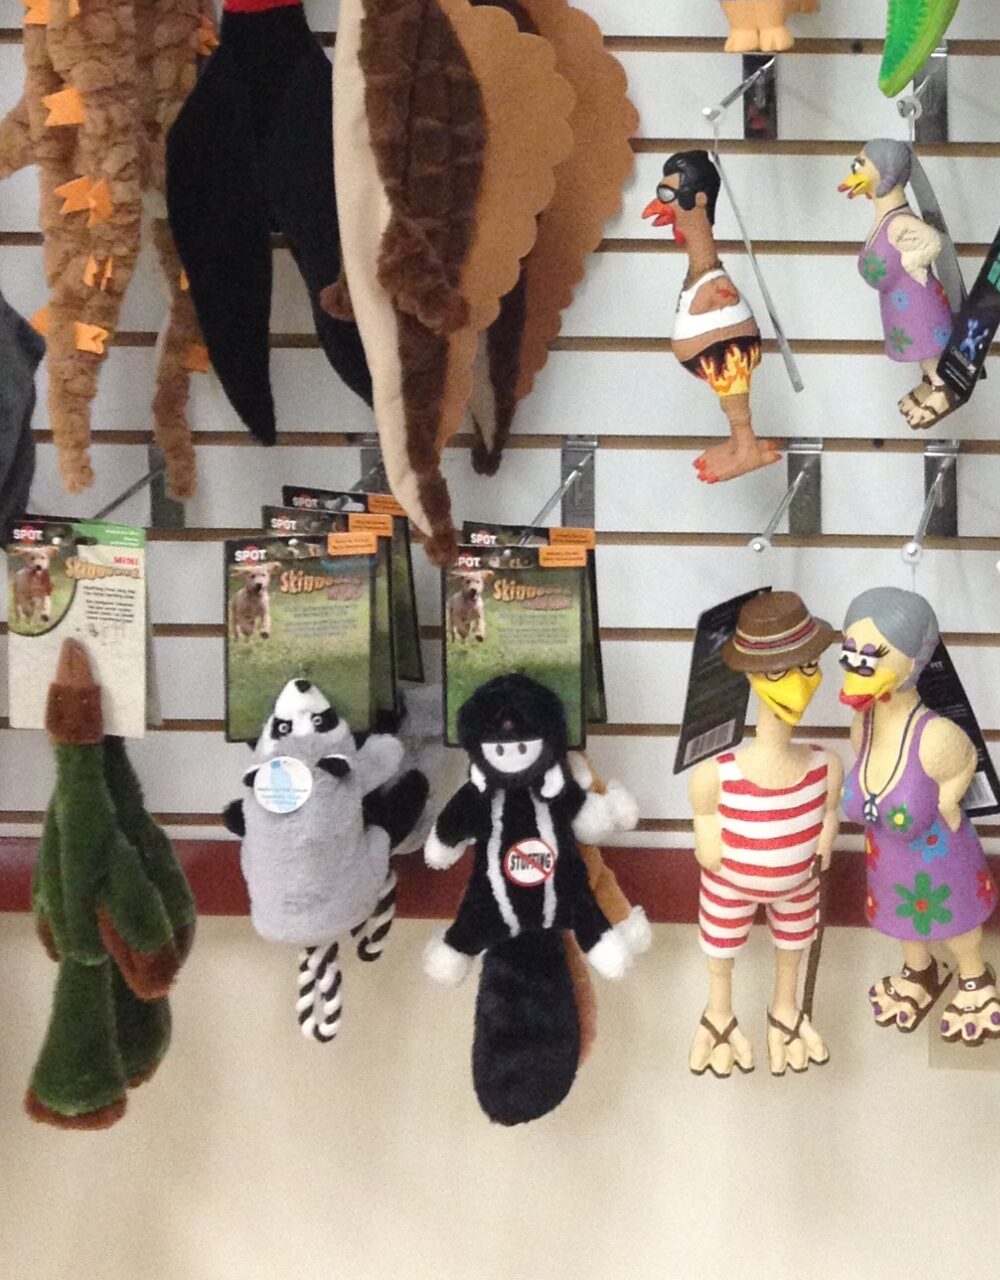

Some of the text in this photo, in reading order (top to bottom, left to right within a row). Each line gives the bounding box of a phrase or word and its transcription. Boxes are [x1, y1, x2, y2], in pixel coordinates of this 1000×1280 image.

[292, 496, 318, 507] SPOT
[271, 518, 296, 531] SPOT
[13, 529, 43, 540] SPOT
[470, 533, 497, 545] SPOT
[234, 549, 267, 562] SPOT
[458, 556, 481, 568] POT
